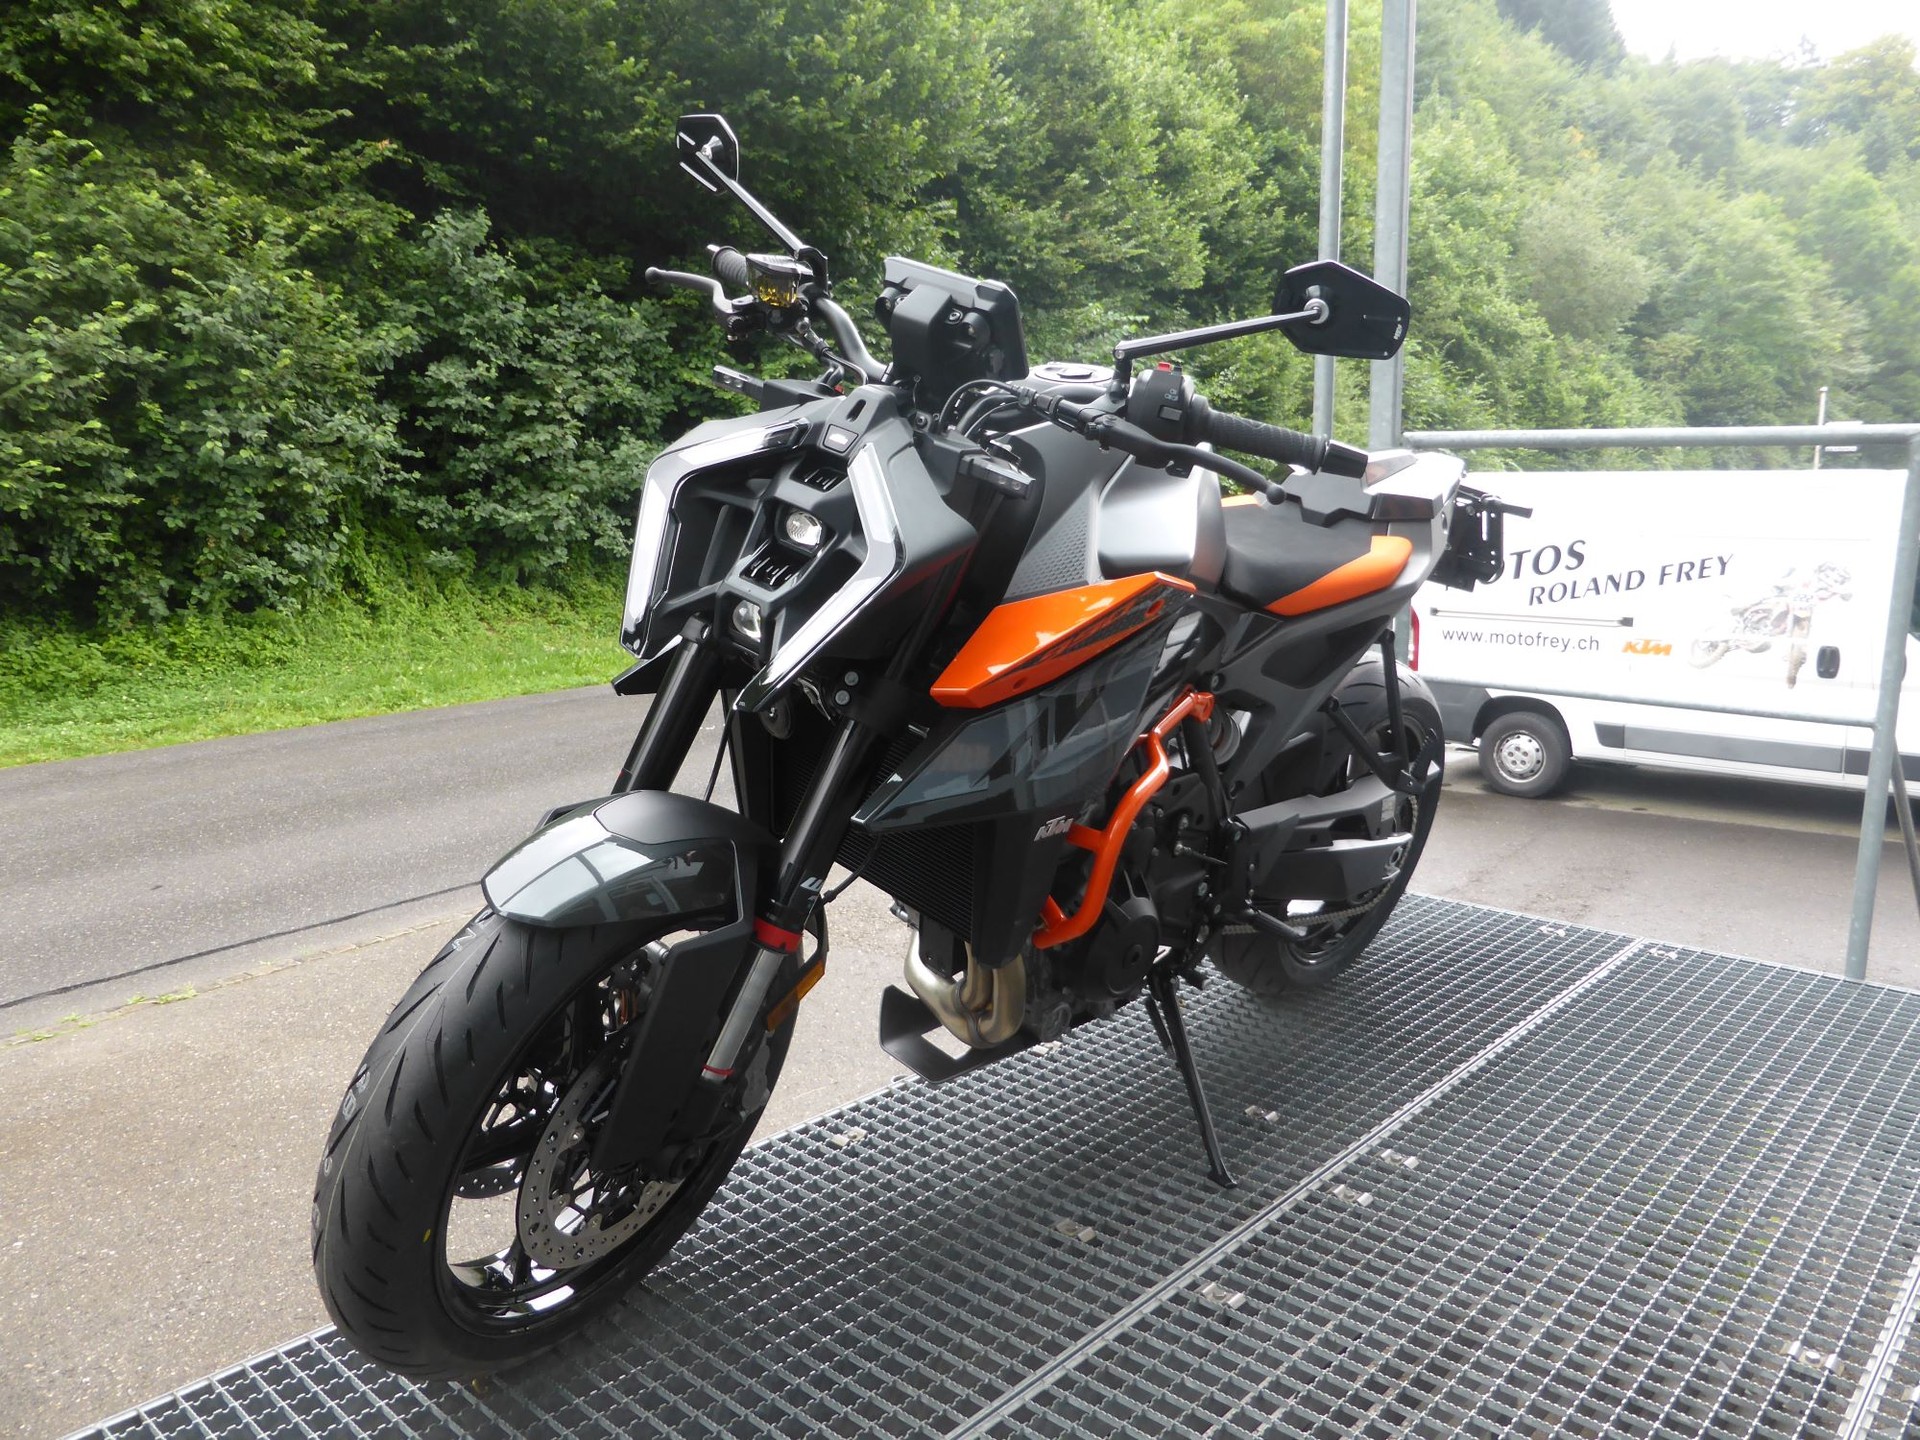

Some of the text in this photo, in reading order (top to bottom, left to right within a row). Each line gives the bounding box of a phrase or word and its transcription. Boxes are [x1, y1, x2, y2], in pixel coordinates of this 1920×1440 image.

[1479, 540, 1587, 585] TOS
[1528, 553, 1734, 606] ROLAND FREY
[1441, 628, 1600, 653] www.motofrey.ch
[1621, 638, 1673, 656] KTM
[1033, 815, 1075, 842] KTM
